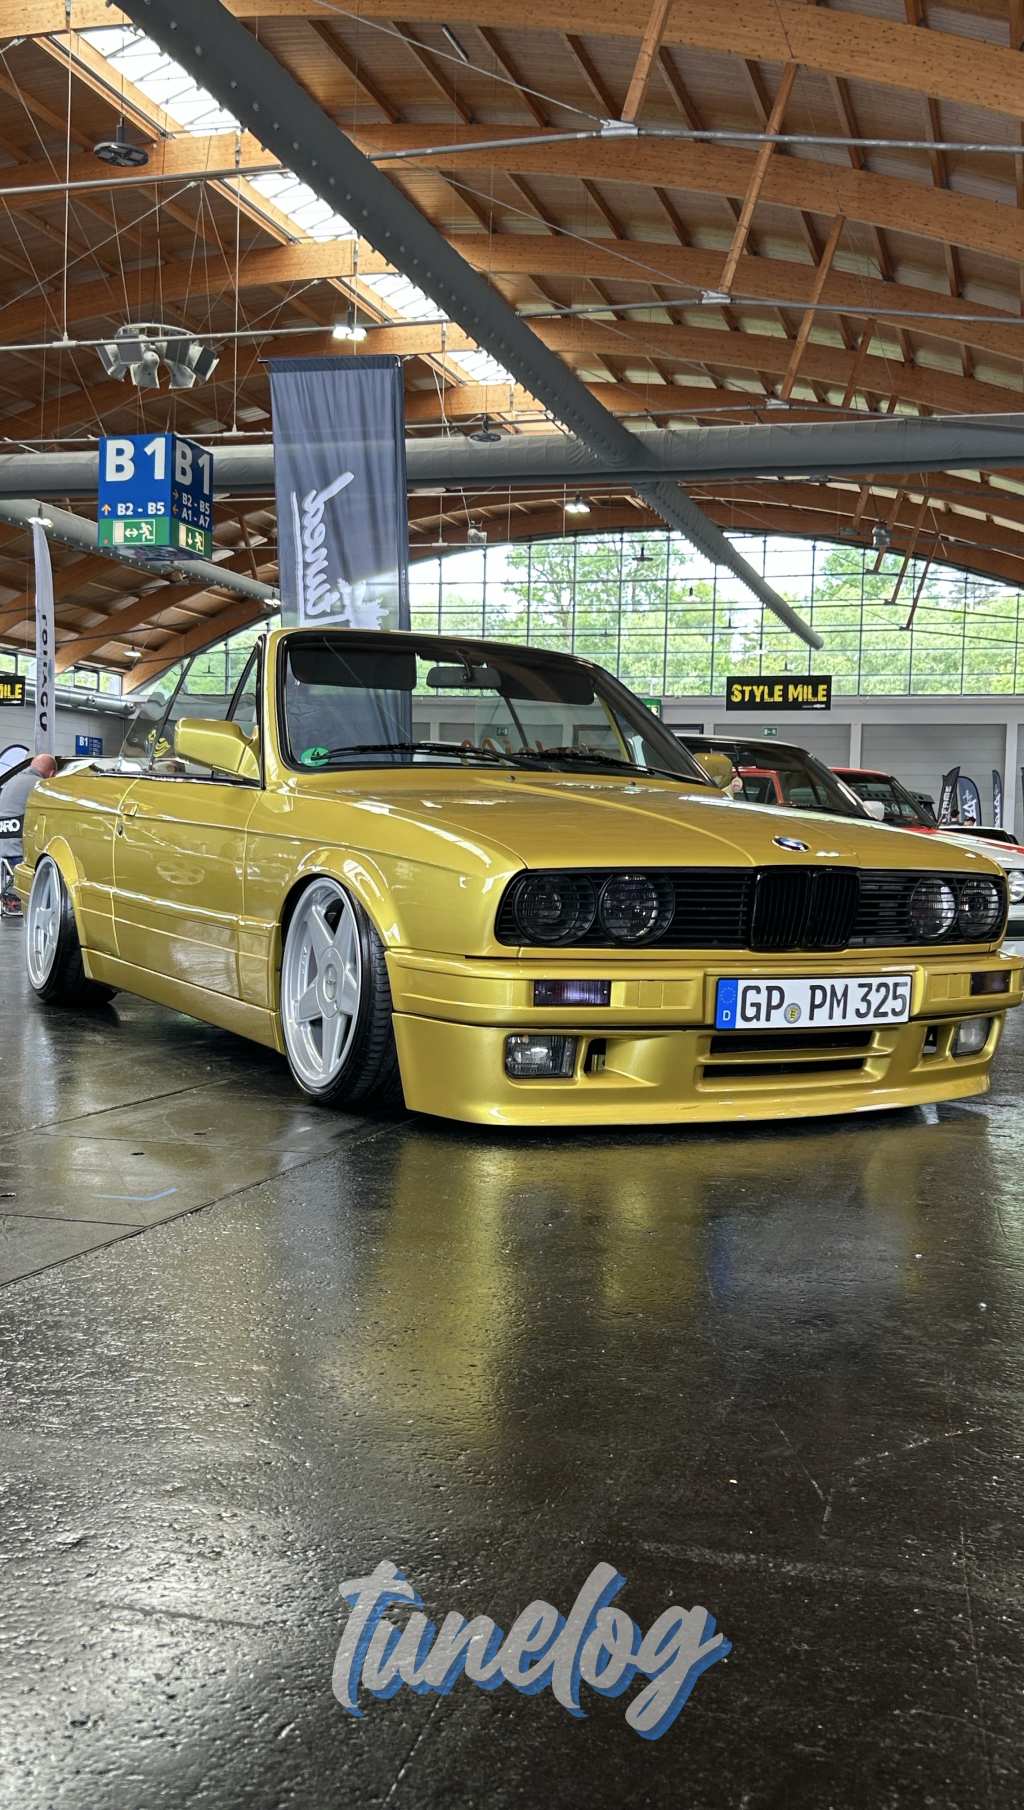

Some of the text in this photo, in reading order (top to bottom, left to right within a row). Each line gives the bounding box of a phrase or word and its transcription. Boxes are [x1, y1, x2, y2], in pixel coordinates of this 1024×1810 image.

[117, 503, 134, 516] B2
[147, 502, 165, 515] B5
[182, 493, 192, 507] B2
[199, 501, 210, 515] B5
[182, 508, 192, 521] A1
[198, 518, 210, 529] A7
[730, 683, 828, 703] STYLE MILE
[740, 982, 909, 1023] GP PM 325
[722, 1009, 731, 1021] D
